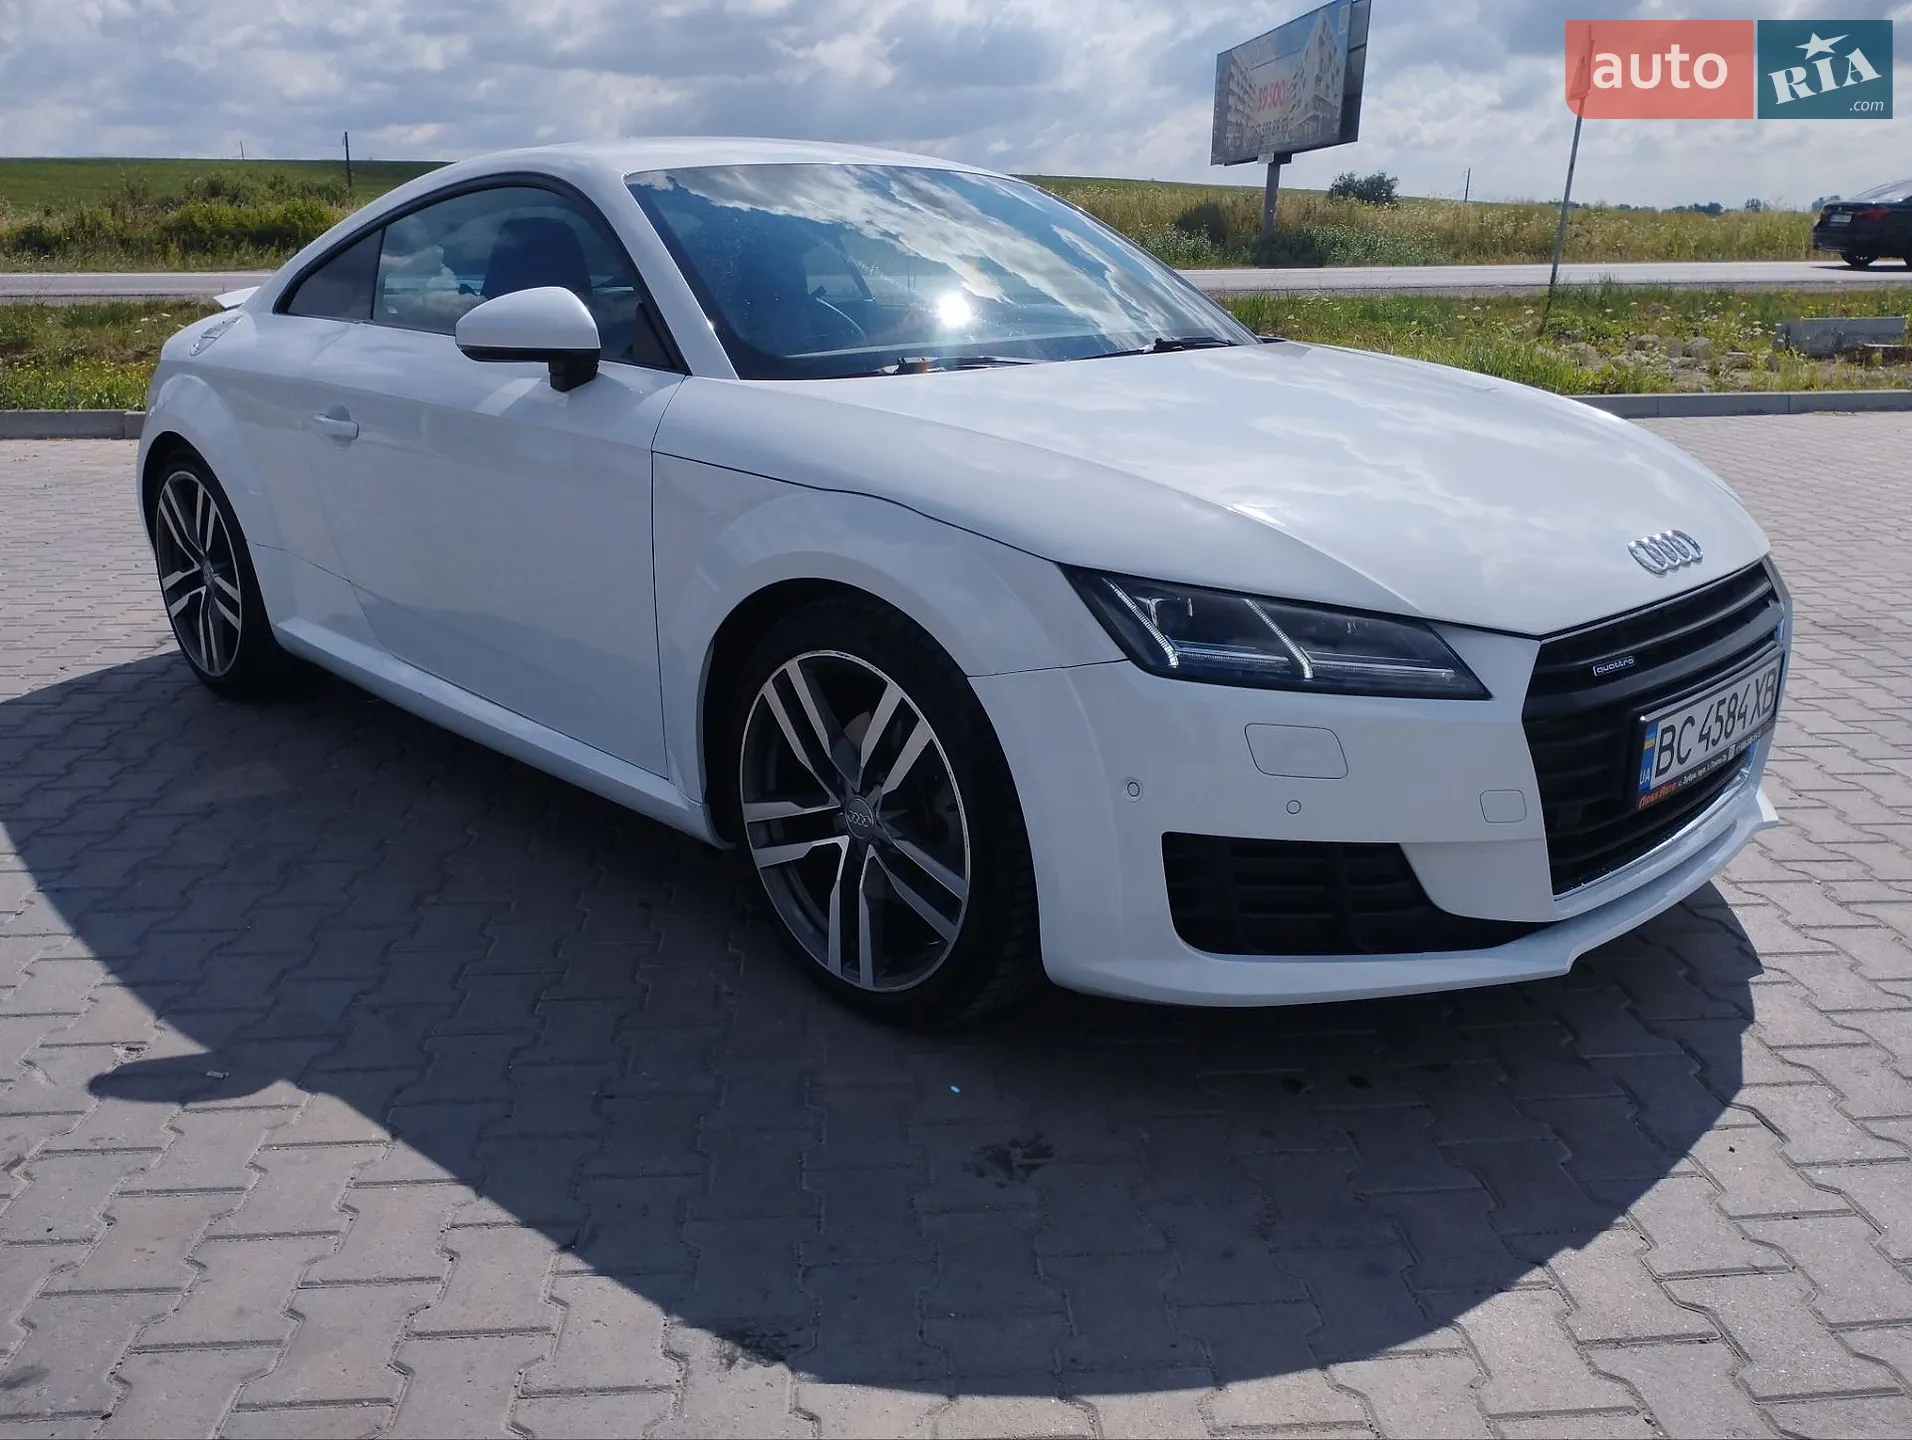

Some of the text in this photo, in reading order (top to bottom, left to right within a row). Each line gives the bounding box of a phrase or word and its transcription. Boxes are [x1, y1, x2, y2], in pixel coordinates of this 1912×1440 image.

[1596, 658, 1635, 674] quattro
[1654, 667, 1777, 779] BC 4584 XB
[1639, 767, 1650, 785] UA
